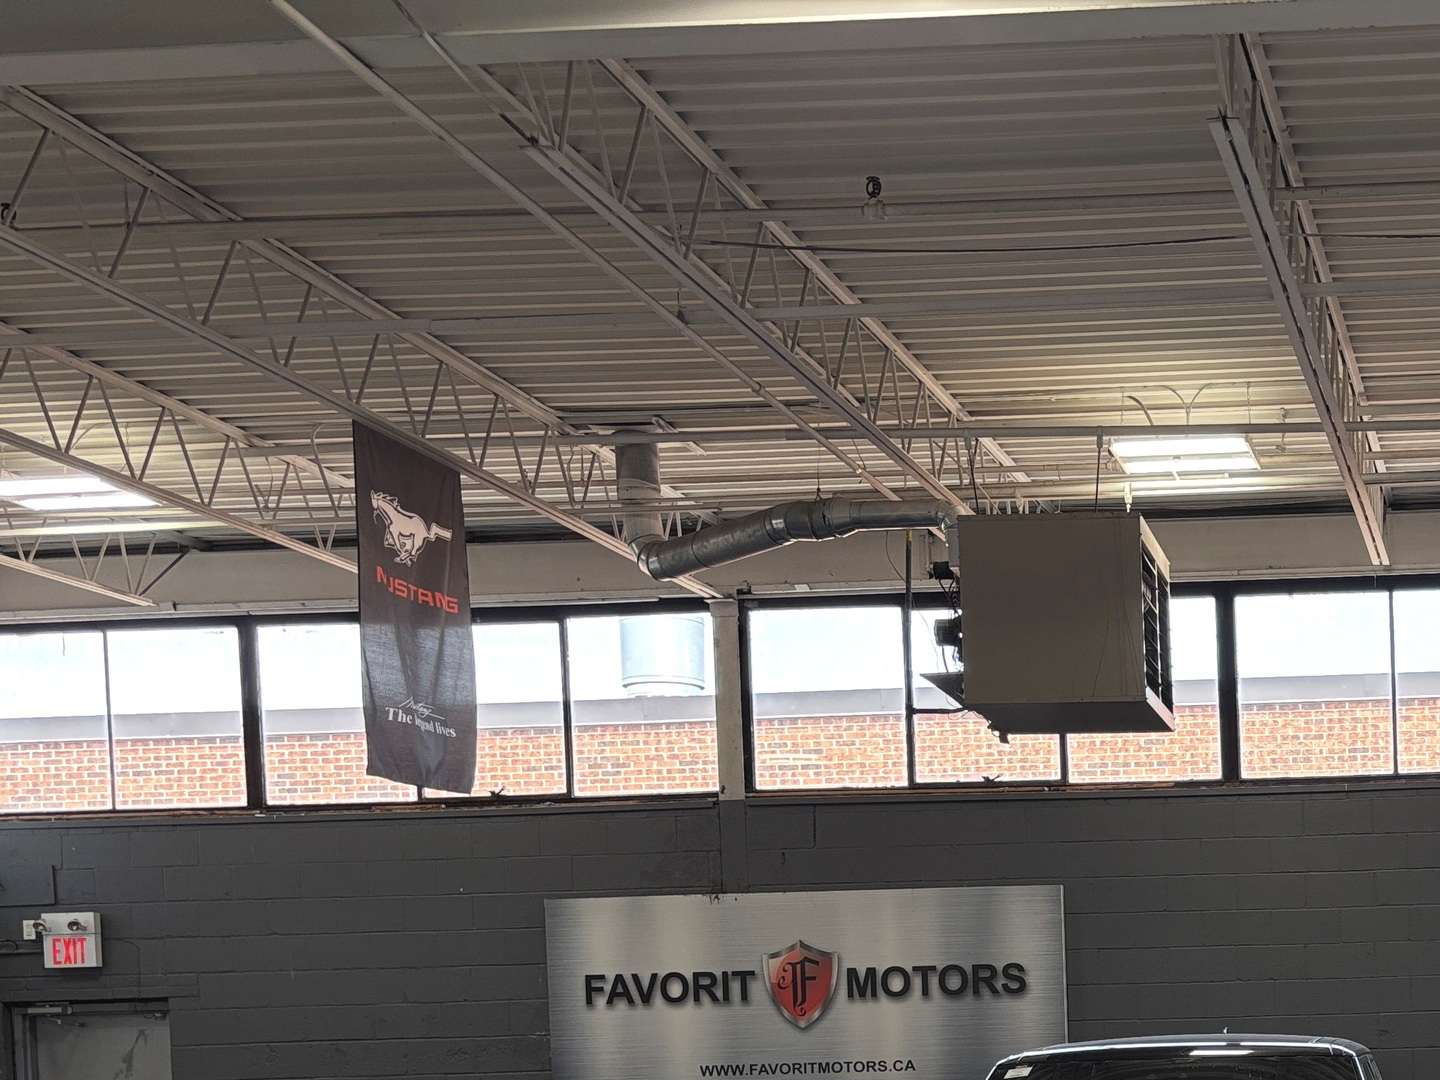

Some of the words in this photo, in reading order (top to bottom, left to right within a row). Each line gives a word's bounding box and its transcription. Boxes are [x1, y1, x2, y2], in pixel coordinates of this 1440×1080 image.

[385, 706, 413, 725] The
[52, 937, 87, 965] EXIT
[585, 970, 755, 1005] FAVORIT
[846, 962, 1027, 998] MOTORS
[700, 1060, 916, 1077] WWW.FAVORITMOTORS.CA
